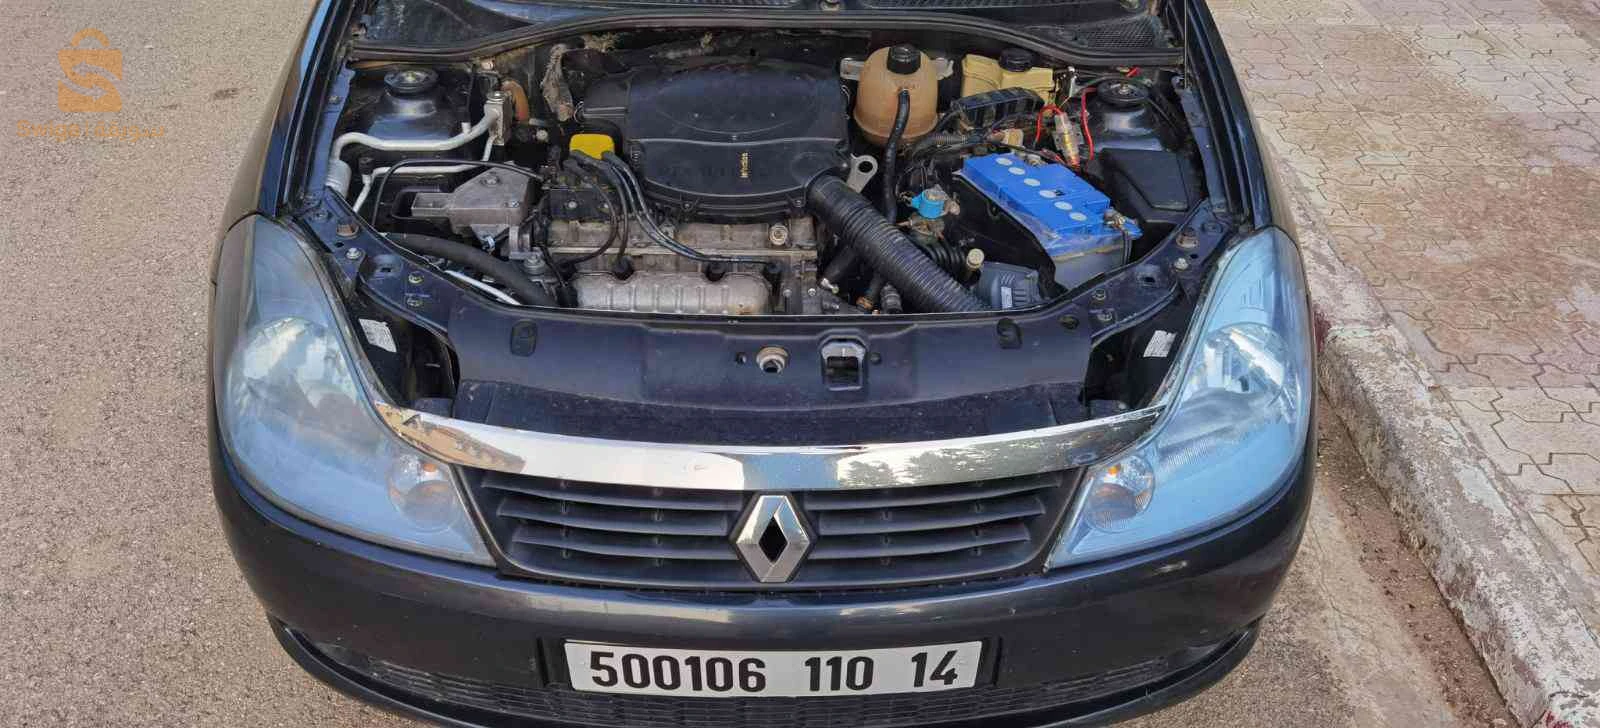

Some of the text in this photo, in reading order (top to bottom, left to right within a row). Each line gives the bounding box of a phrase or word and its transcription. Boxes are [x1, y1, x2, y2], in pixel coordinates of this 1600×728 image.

[589, 650, 959, 693] 500106 110 14
